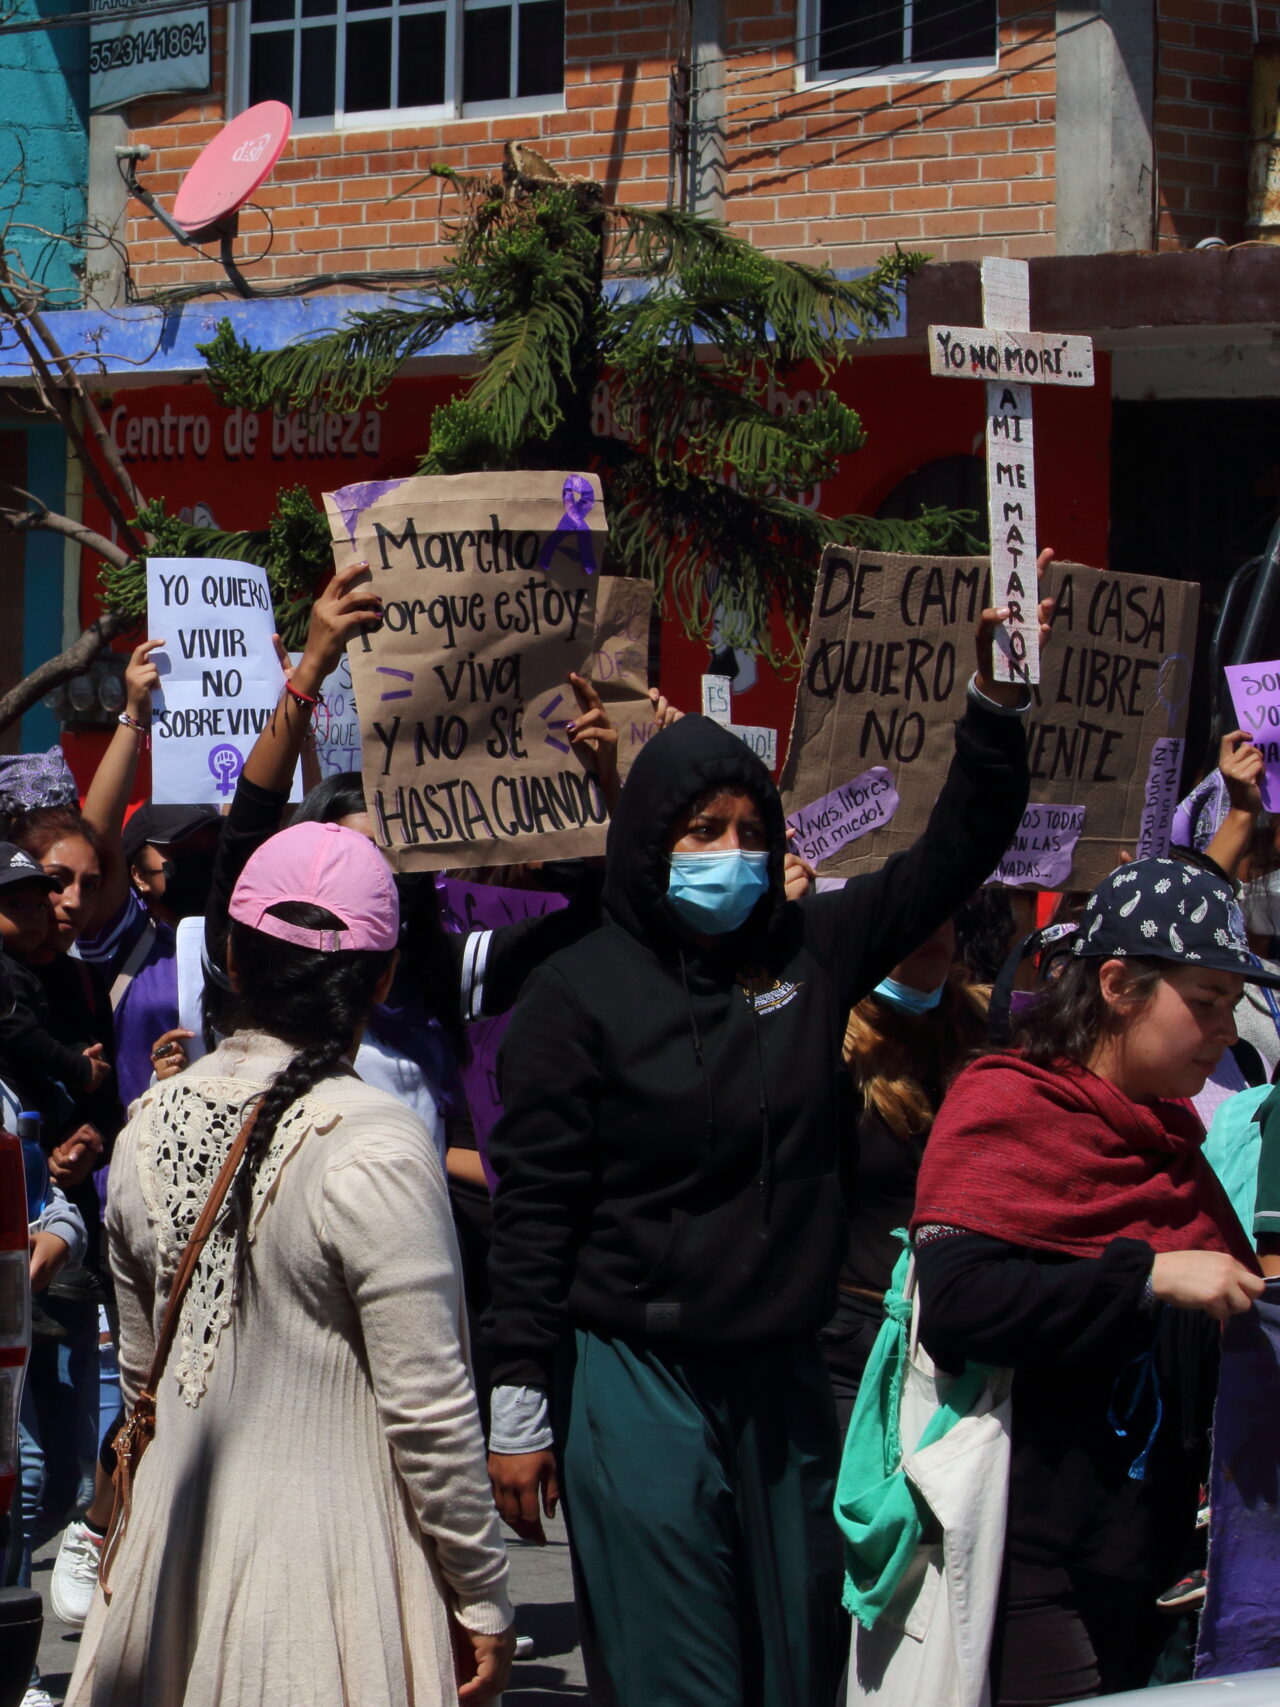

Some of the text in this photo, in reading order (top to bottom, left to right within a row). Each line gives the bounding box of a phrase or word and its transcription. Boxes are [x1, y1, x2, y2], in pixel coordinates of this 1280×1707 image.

[937, 331, 966, 369] YO
[970, 345, 1001, 373] NO
[1000, 388, 1018, 410] A
[110, 404, 210, 455] Centro
[224, 404, 259, 454] de
[993, 415, 1023, 443] MI
[997, 462, 1027, 489] ME
[372, 514, 540, 574] Marcho
[159, 574, 269, 611] YO QUIERO
[495, 577, 588, 642] estoy
[819, 557, 881, 620] DE
[1051, 573, 1074, 632] A
[1088, 579, 1165, 653] CASA
[1003, 502, 1031, 682] MATARON
[178, 628, 247, 659] VIVIR
[202, 669, 242, 697] NO
[807, 638, 956, 701] QUIERO
[1056, 646, 1162, 717] LIBRE
[708, 686, 728, 712] ES
[330, 722, 357, 746] QUE
[373, 716, 401, 775] Y
[415, 715, 468, 767] NO
[859, 709, 926, 763] NO
[375, 770, 607, 847] HASTA CUANDO
[837, 776, 890, 813] libres
[803, 799, 885, 860] sin miedo!
[1021, 810, 1085, 830] OS TODAS
[1031, 835, 1061, 852] LAS
